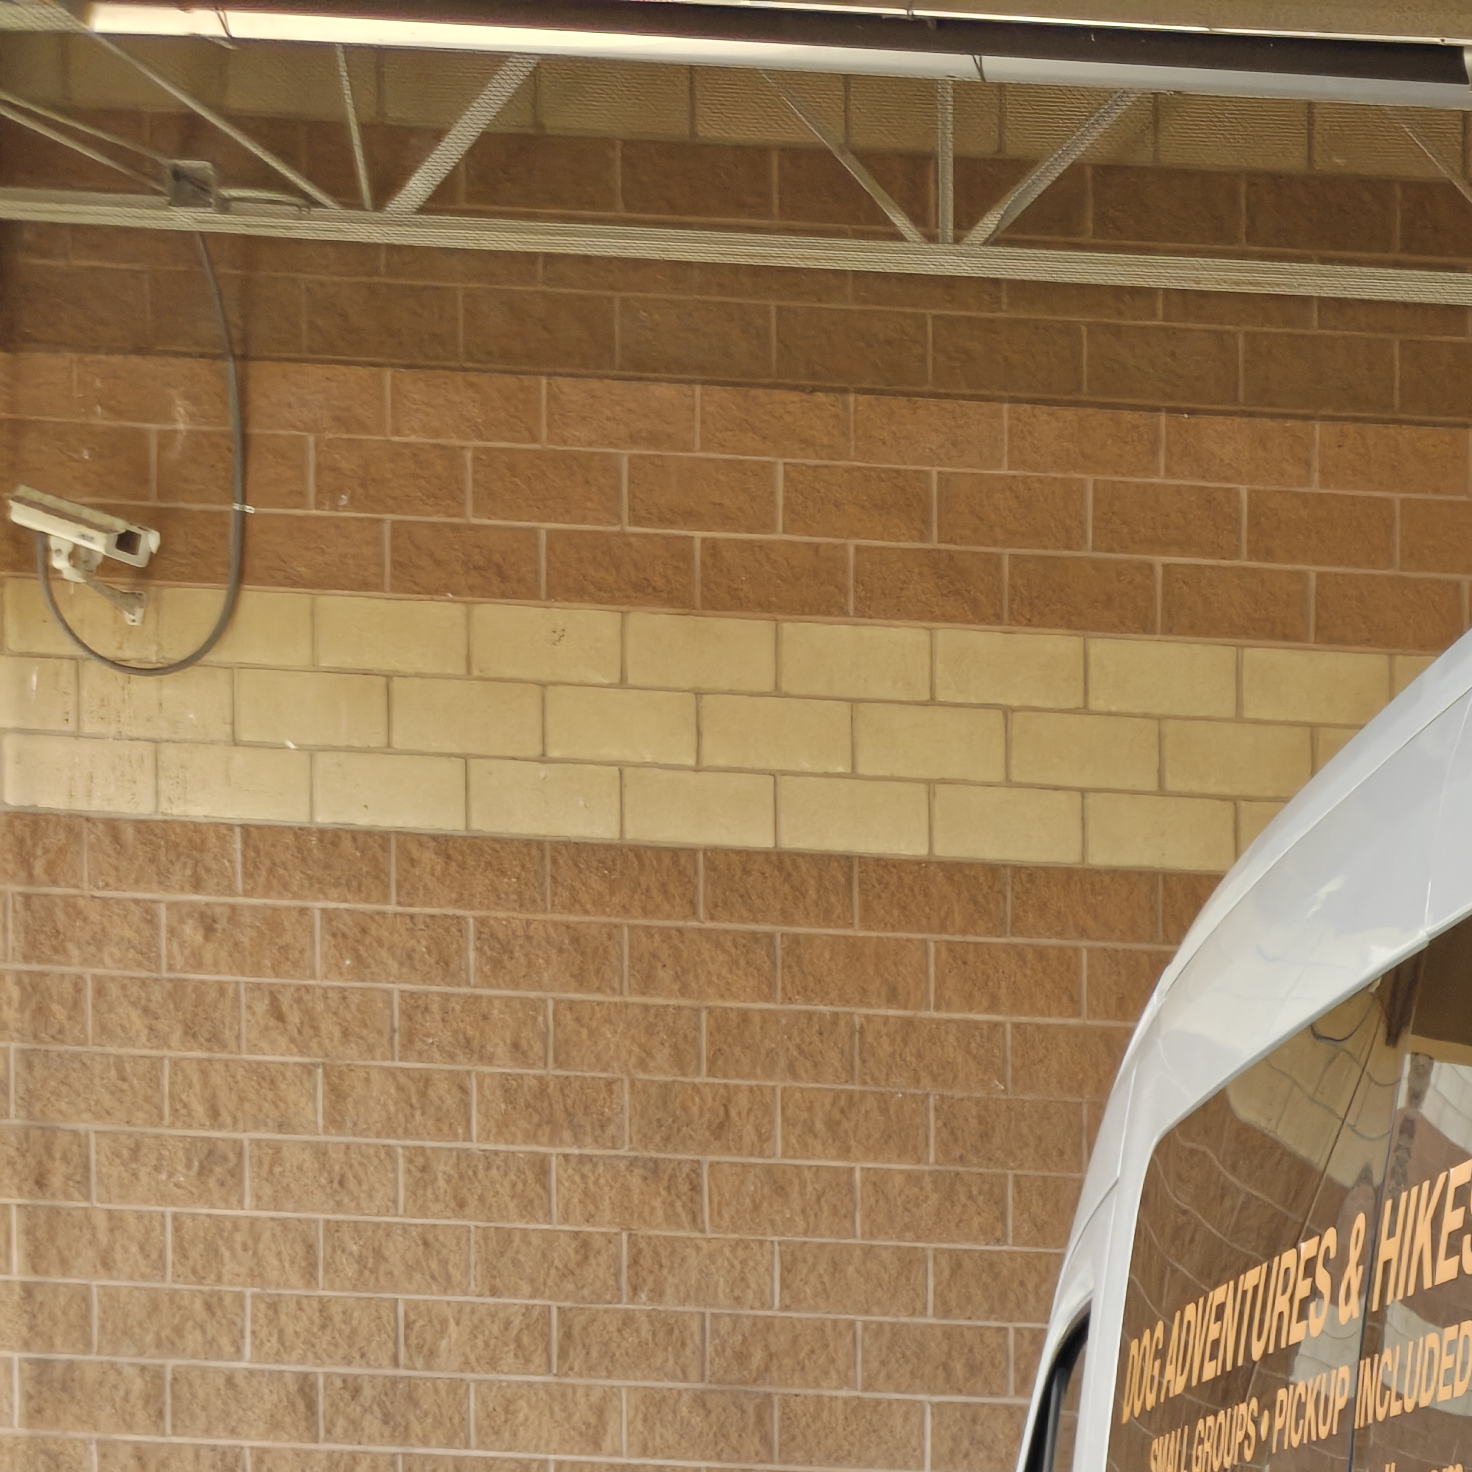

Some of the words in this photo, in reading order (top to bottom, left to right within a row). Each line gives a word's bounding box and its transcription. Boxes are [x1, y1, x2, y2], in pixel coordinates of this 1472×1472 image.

[1121, 1328, 1163, 1425] DOG
[1162, 1226, 1338, 1399] ADVENTURES
[1338, 1212, 1368, 1326] &
[1270, 1365, 1352, 1453] PICKUP
